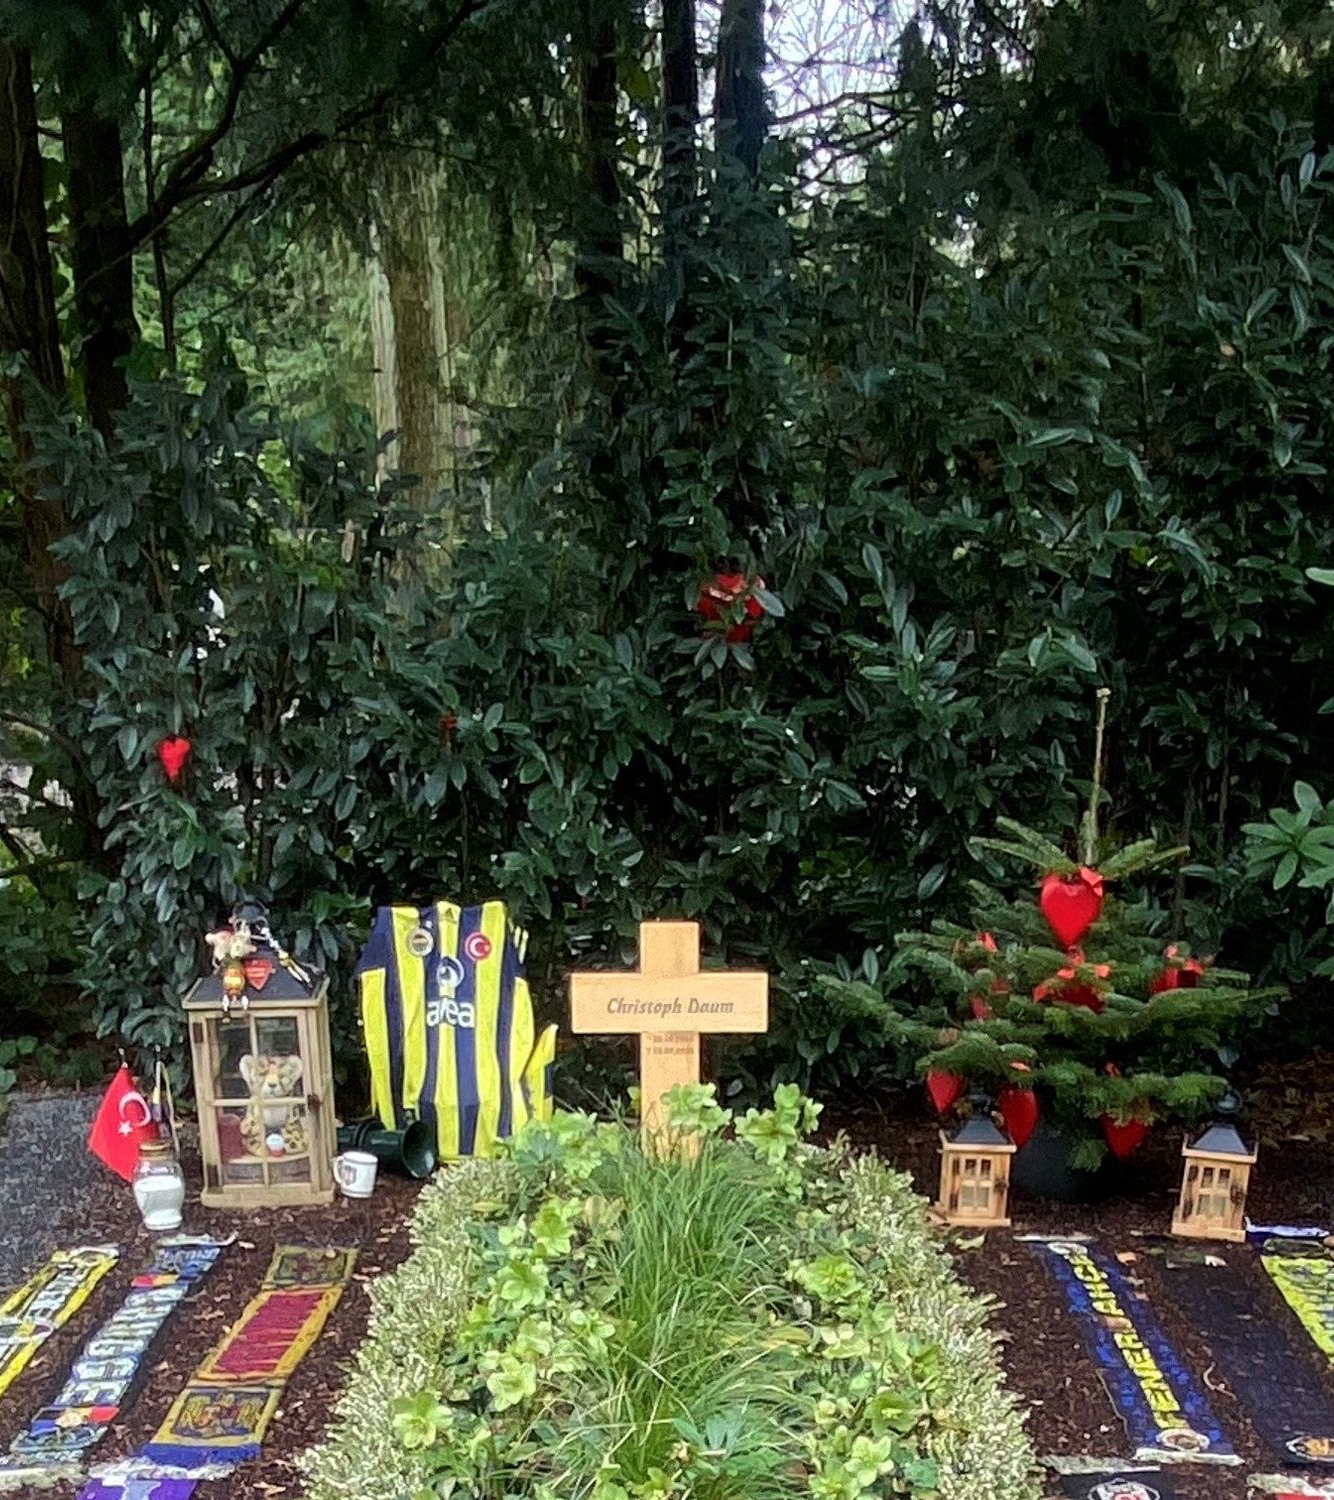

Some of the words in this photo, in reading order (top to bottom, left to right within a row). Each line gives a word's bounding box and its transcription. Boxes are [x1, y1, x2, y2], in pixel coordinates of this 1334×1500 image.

[607, 997, 682, 1018] Christoph
[687, 998, 734, 1014] Daum
[1064, 1254, 1189, 1428] FENERAHÇE
